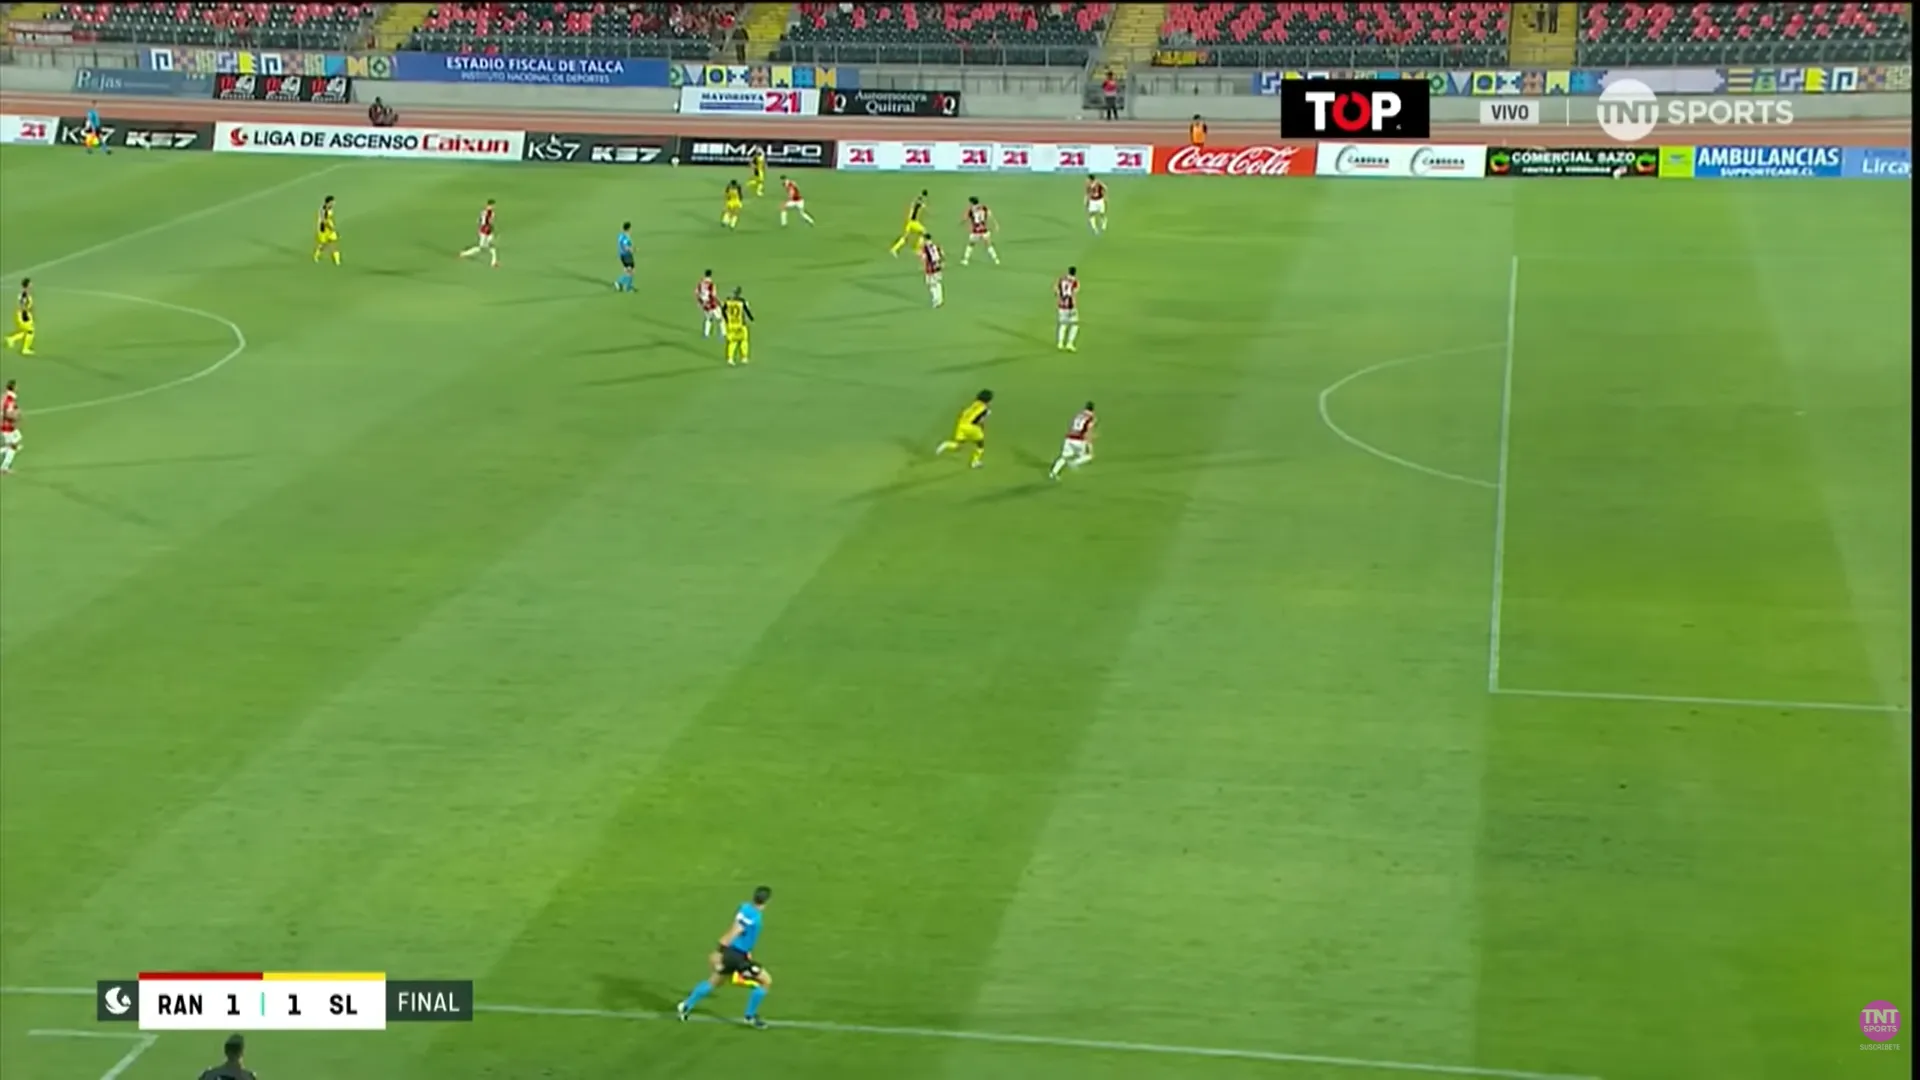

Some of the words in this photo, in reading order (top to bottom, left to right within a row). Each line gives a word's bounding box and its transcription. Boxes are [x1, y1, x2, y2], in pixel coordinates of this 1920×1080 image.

[446, 56, 504, 70] ESTADIO
[509, 58, 553, 72] FISCAL
[558, 60, 576, 72] DE
[580, 60, 624, 73] TALCA
[765, 92, 801, 113] 21
[866, 102, 916, 113] Quitral
[253, 130, 295, 147] LIGA
[301, 132, 326, 147] DE
[329, 133, 418, 150] ASCENSO
[421, 134, 509, 154] Caixun
[725, 143, 822, 156] MALPO
[850, 148, 874, 164] 21
[906, 149, 931, 165] 21
[962, 149, 987, 166] 21
[1004, 151, 1028, 166] 21
[1060, 151, 1084, 166] 21
[1117, 151, 1142, 167] 21
[1512, 151, 1593, 165] COMERCIAL
[1698, 147, 1839, 167] AMBULANCIAS
